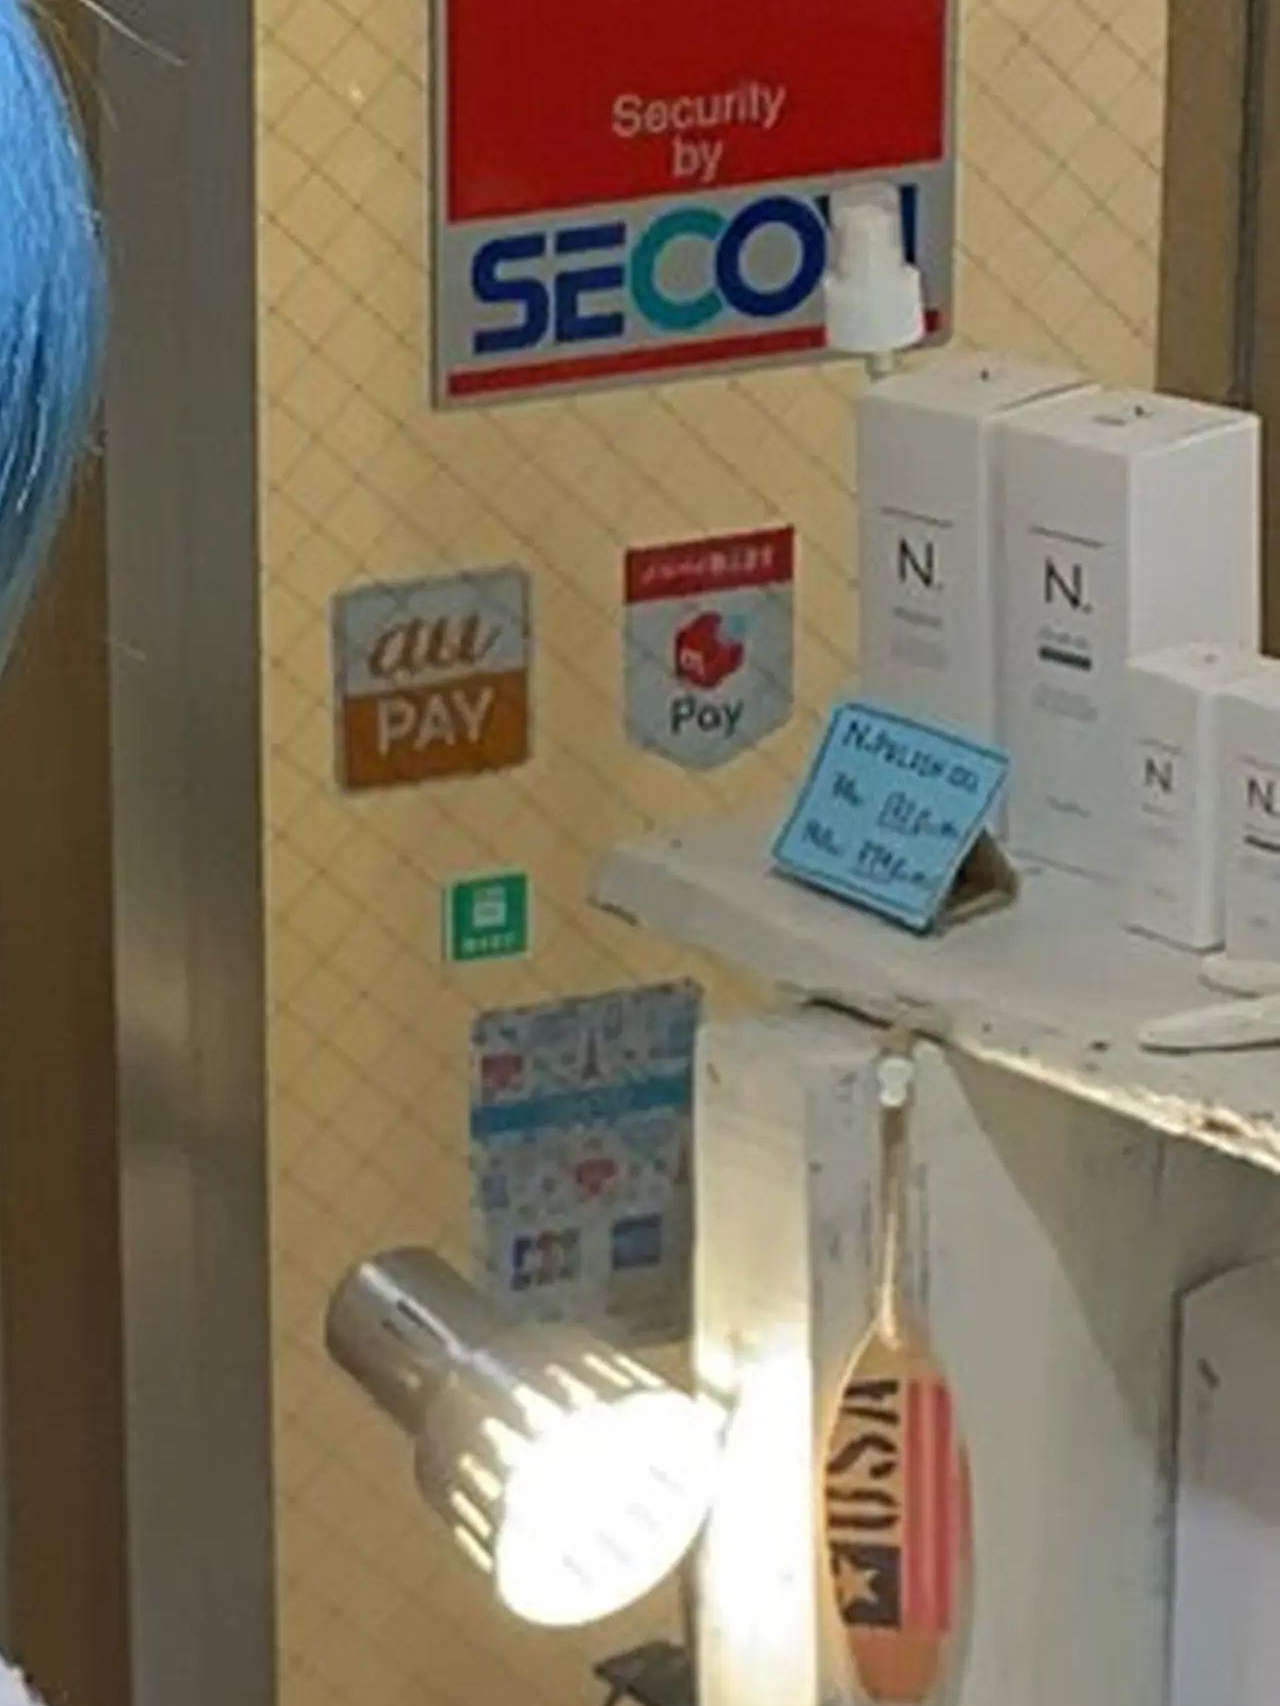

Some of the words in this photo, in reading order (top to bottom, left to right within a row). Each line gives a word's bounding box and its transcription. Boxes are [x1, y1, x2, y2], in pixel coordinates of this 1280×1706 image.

[611, 79, 787, 137] Security
[672, 137, 724, 182] by
[366, 612, 500, 681] au
[375, 686, 493, 756] PAY
[668, 697, 744, 738] Pay
[823, 1377, 901, 1531] USA
